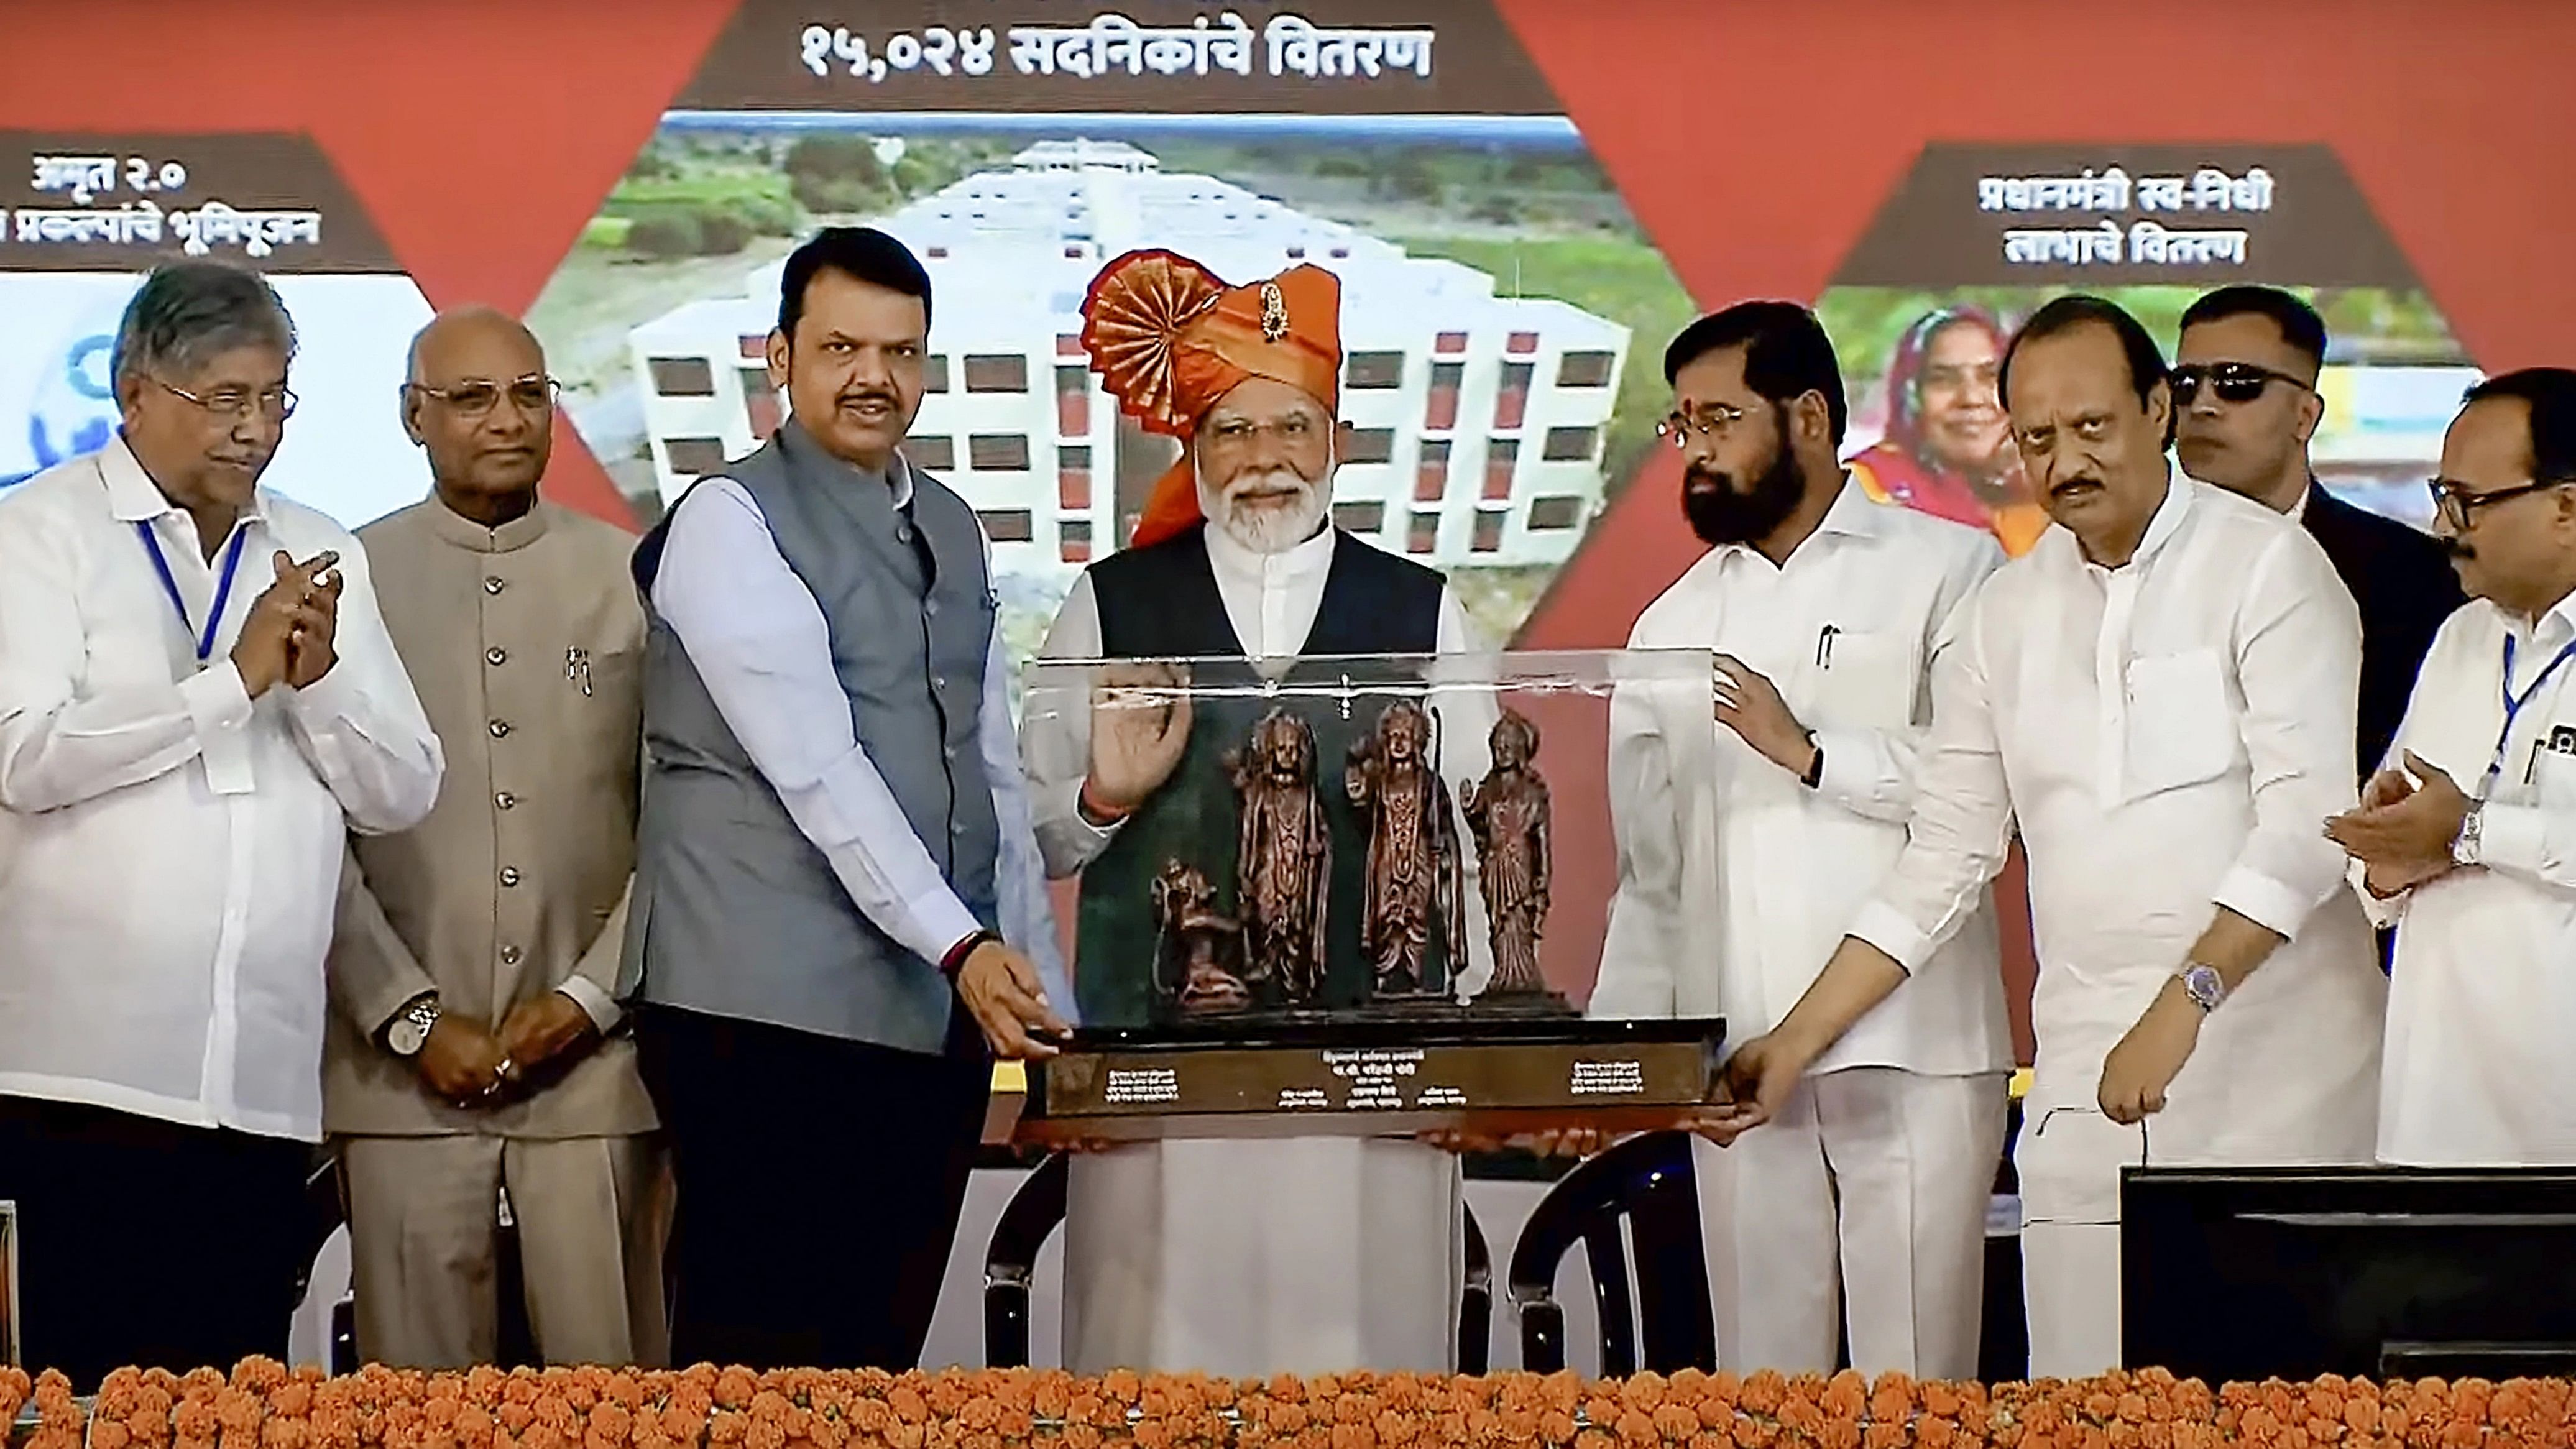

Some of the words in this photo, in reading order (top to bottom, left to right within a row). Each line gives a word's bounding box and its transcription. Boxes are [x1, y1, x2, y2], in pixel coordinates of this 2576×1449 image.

[801, 25, 996, 83] १५,०२४
[1007, 11, 1256, 80] सदनिकांचे
[1263, 14, 1437, 78] वितरण
[31, 155, 118, 205] अमृत
[125, 157, 186, 193] २.०
[1977, 167, 2133, 211] प्रधानमंत्री
[2137, 167, 2276, 213] स्व-निधी
[14, 199, 165, 245] प्रकल्पांचे
[167, 200, 323, 257] भूमिपूजन
[2003, 218, 2125, 264] लाभाचे
[2128, 220, 2249, 265] वितरण
